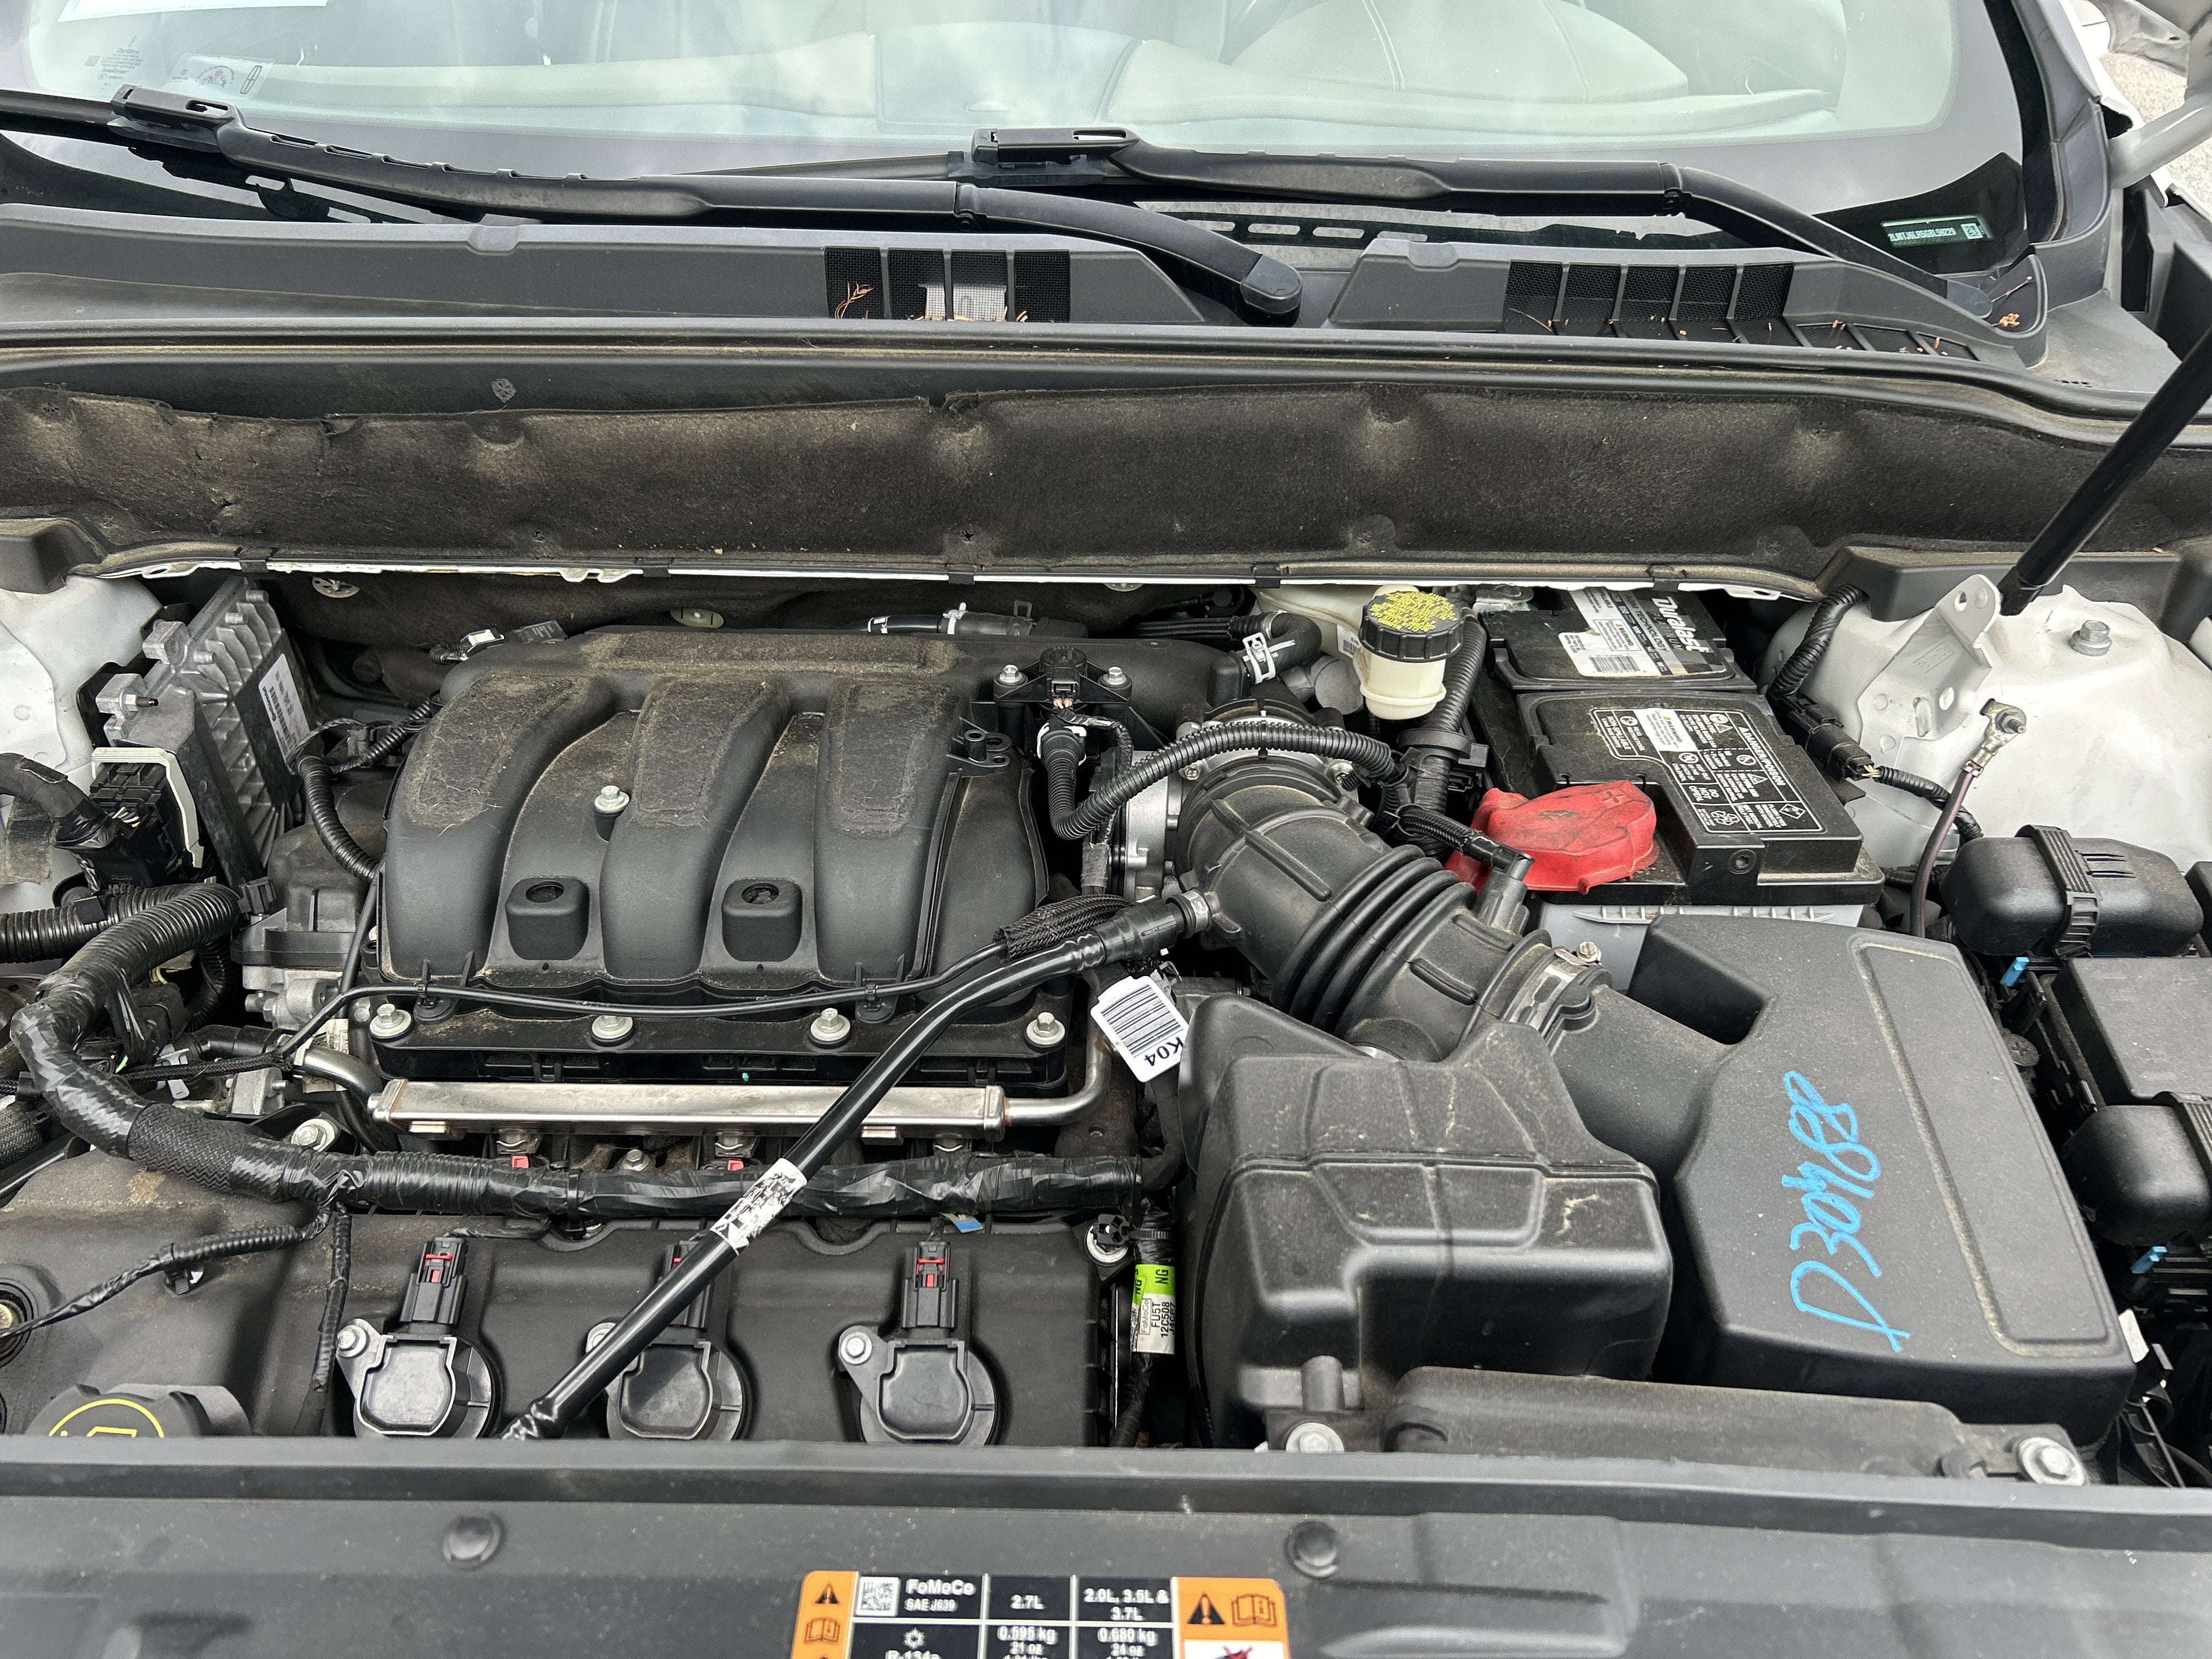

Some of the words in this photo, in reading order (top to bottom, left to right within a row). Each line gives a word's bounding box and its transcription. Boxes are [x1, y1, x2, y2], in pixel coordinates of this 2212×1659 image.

[1634, 611, 1667, 651] TECHNOLOGY
[1651, 596, 1708, 652] Duralast
[1651, 613, 1683, 650] PLATINUM
[1606, 716, 1632, 749] NON-SPILLABLE
[1742, 732, 1787, 785] DANGER/POISON
[1687, 785, 1705, 802] OPEN.
[1697, 787, 1713, 799] NOT
[1707, 789, 1720, 797] DO
[1144, 1036, 1183, 1067] K04
[1155, 1269, 1169, 1284] NG
[1141, 1299, 1149, 1333] FoMoCo
[1151, 1301, 1161, 1328] FU5T
[1160, 1301, 1170, 1338] 12C508
[905, 1578, 976, 1595] FoMoCo
[904, 1599, 928, 1612] SAE
[1010, 1595, 1044, 1610] 2.7L
[1155, 1589, 1169, 1604] &
[1110, 1606, 1143, 1621] 3.7L
[1037, 1627, 1058, 1645] kg
[1137, 1628, 1159, 1646] kg
